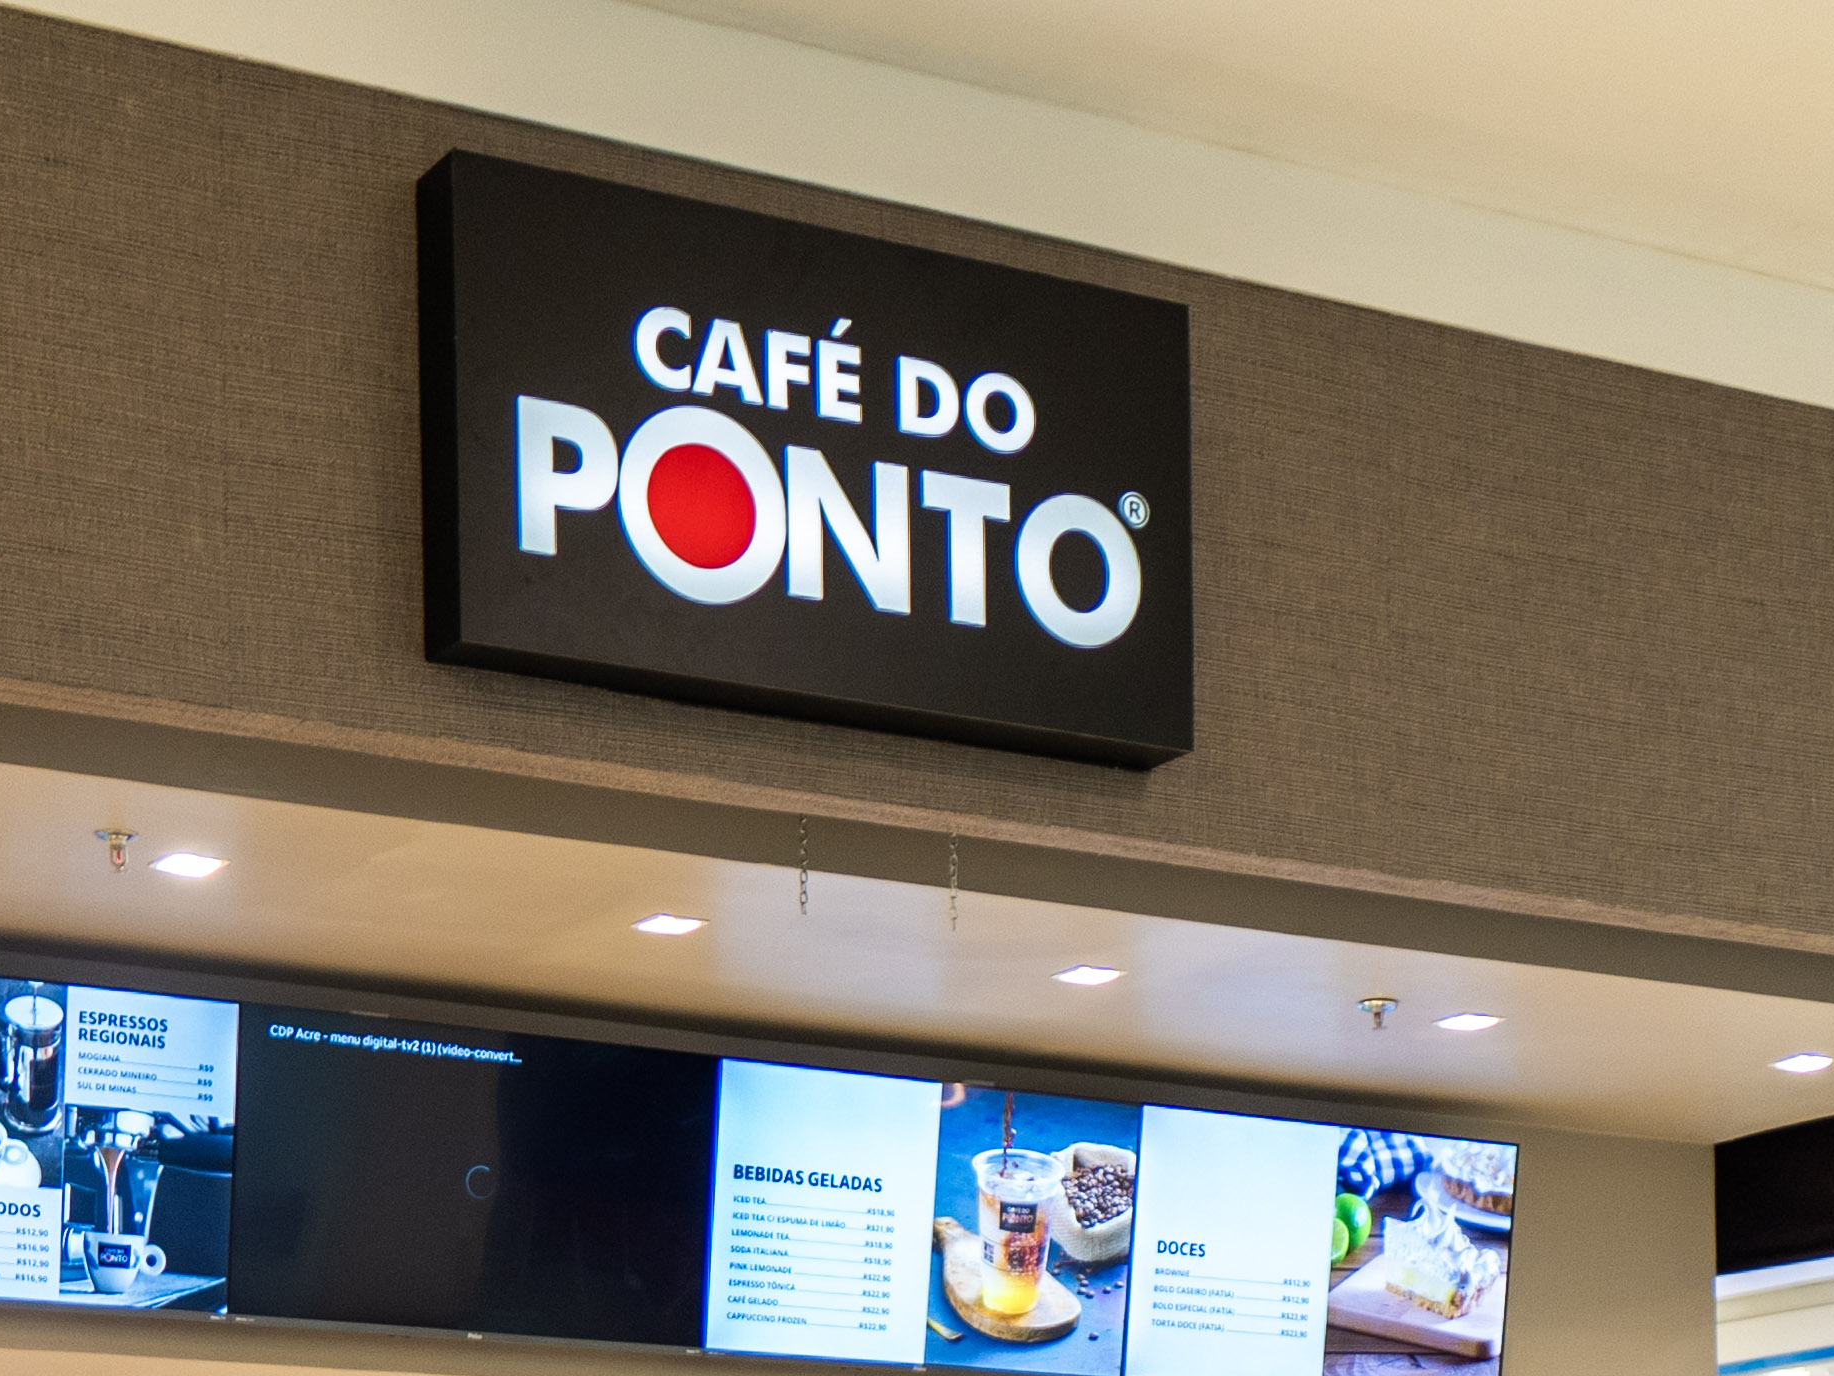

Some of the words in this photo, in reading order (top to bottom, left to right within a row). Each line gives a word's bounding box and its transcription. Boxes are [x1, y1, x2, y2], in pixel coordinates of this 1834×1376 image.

[634, 306, 863, 424] CAFÉ
[897, 355, 1036, 453] DO
[515, 394, 1141, 649] PONTO
[79, 1011, 168, 1032] ESPRESSOS
[79, 1028, 166, 1049] REGIONAIS
[269, 1024, 294, 1037] CDP
[295, 1027, 321, 1040] Acre
[330, 1033, 361, 1045] menu
[362, 1034, 420, 1052] digital-tv2
[421, 1042, 436, 1055] (1)
[78, 1052, 120, 1062] MOGIANA
[78, 1067, 117, 1077] CERRADO
[120, 1071, 157, 1081] MINEIRO
[78, 1081, 92, 1090] SUL
[96, 1083, 106, 1091] DE
[109, 1085, 137, 1093] MINAS
[733, 1164, 804, 1185] BEBIDAS
[808, 1172, 883, 1192] GELADAS
[733, 1195, 751, 1203] ICED
[753, 1197, 766, 1205] TEA
[733, 1212, 749, 1220] ICED
[752, 1213, 765, 1222] TEA
[777, 1216, 807, 1225] ESPUMA
[821, 1219, 845, 1228] LIMÃO
[16, 1227, 49, 1237] R$12,90
[732, 1229, 773, 1239] LEMONADE
[777, 1232, 789, 1240] TEA
[731, 1245, 751, 1254] SODA
[753, 1248, 788, 1257] ITALIANA
[1157, 1240, 1206, 1257] DOCES
[17, 1259, 49, 1268] R$12,90
[729, 1262, 748, 1270] PINK
[750, 1264, 792, 1274] LEMONADE
[1155, 1268, 1190, 1277] BROWNIE
[729, 1279, 765, 1288] ESPRESSO
[767, 1281, 795, 1290] TÔNICA
[1154, 1285, 1174, 1293] BOLO
[1176, 1287, 1207, 1296] CASEIRO
[727, 1295, 745, 1303] CAFÉ
[748, 1297, 778, 1306] GELADO
[1153, 1302, 1173, 1310] BOLO
[1175, 1303, 1207, 1313] ESPECIAL
[727, 1312, 775, 1322] CAPPUCCINO
[778, 1316, 807, 1325] FROZEN
[1152, 1319, 1176, 1327] TORTA
[1177, 1321, 1196, 1330] DOCE
